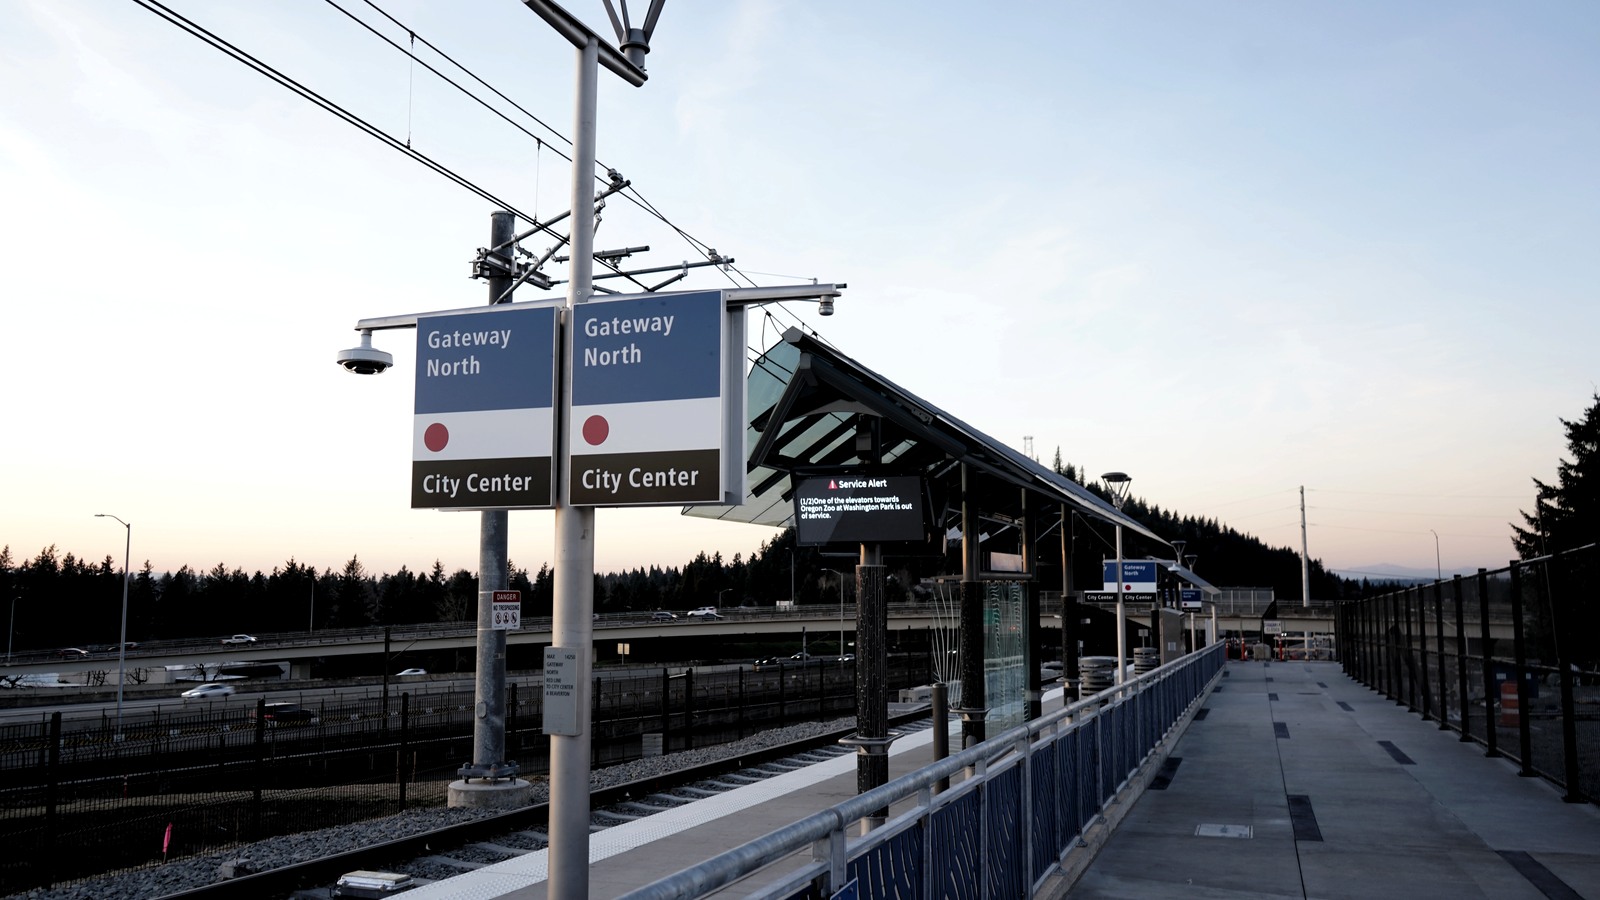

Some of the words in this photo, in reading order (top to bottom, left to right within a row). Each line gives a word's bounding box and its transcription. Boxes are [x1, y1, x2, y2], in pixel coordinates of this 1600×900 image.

[584, 316, 674, 337] Gateway
[428, 329, 511, 349] Gateway
[584, 344, 642, 367] North
[427, 356, 480, 377] North
[423, 474, 460, 498] City
[466, 474, 532, 492] Center
[582, 469, 622, 494] City
[628, 468, 699, 488] Center
[838, 480, 866, 489] Service
[868, 479, 887, 488] Alert
[800, 498, 826, 506] (1/2)One
[801, 505, 822, 513] Oregon
[843, 504, 879, 512] Washington
